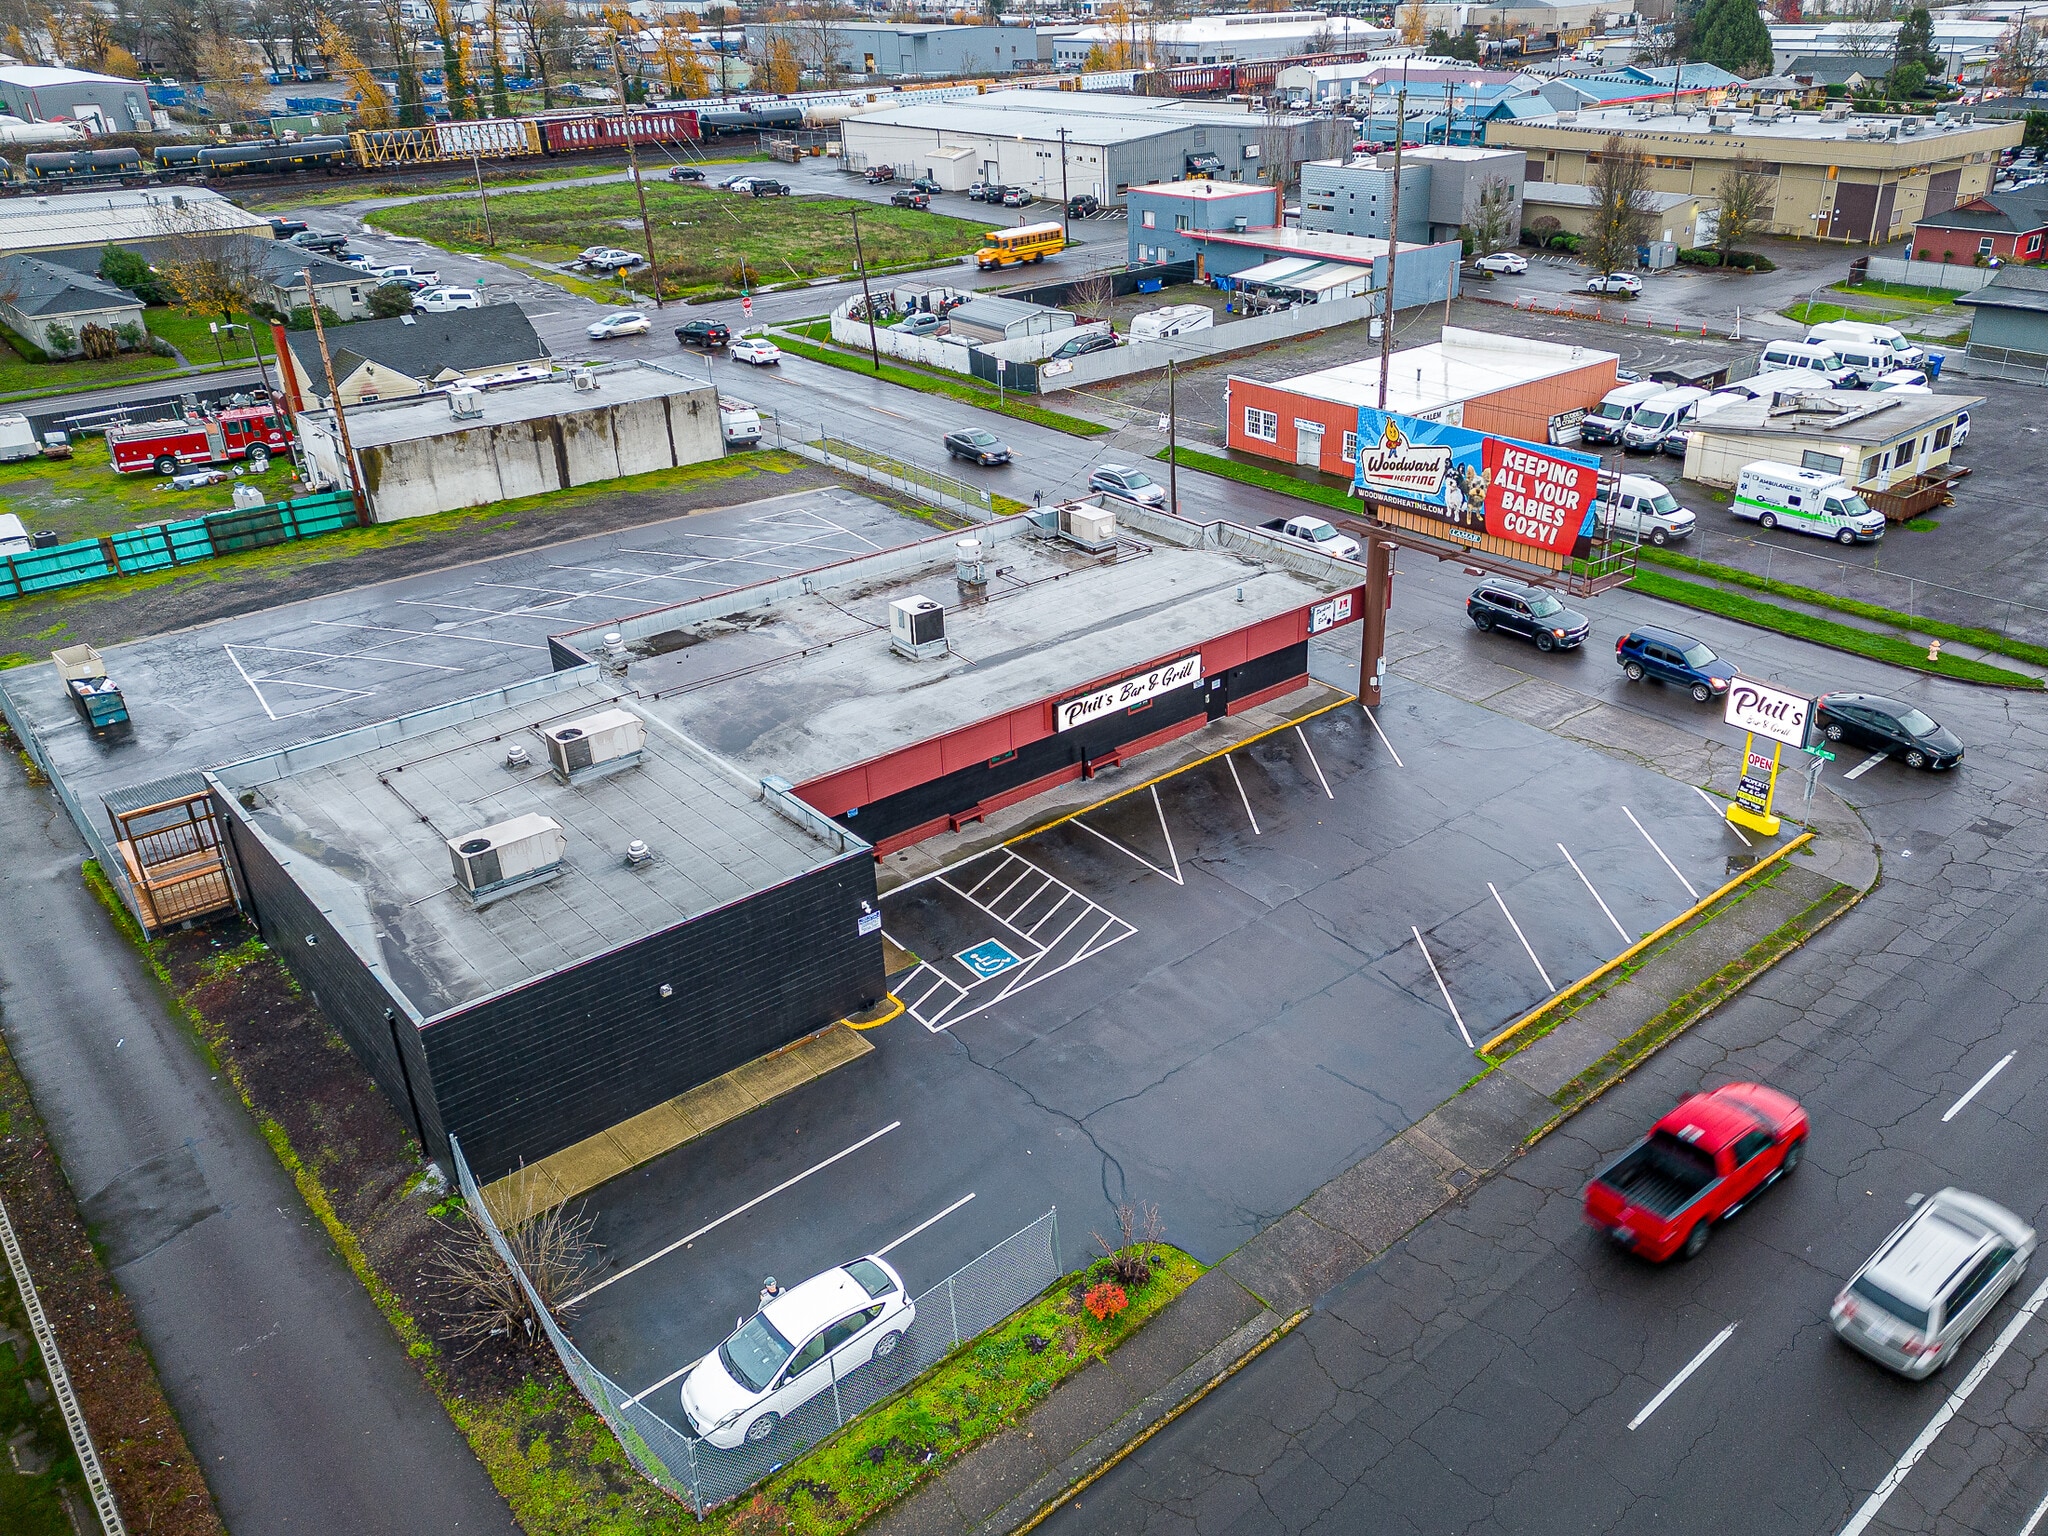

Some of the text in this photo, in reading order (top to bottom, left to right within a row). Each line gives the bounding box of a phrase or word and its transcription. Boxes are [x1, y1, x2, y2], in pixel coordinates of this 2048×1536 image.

[1368, 452, 1441, 472] Woodward
[1501, 447, 1579, 488] KEEPING
[1394, 474, 1436, 486] HEATING
[1493, 467, 1580, 510] ALL YOUR
[1759, 478, 1794, 491] AMBULANCE
[1357, 488, 1444, 515] WOODWARDHEATING.COM
[1500, 491, 1566, 528] BABIES
[1502, 512, 1559, 546] COZY!
[1064, 693, 1113, 725] Phil's
[1119, 682, 1145, 702] Bar
[1148, 673, 1159, 691] &
[1161, 660, 1194, 687] Grill
[1732, 686, 1804, 726] Phil's
[1747, 753, 1773, 771] OPEN
